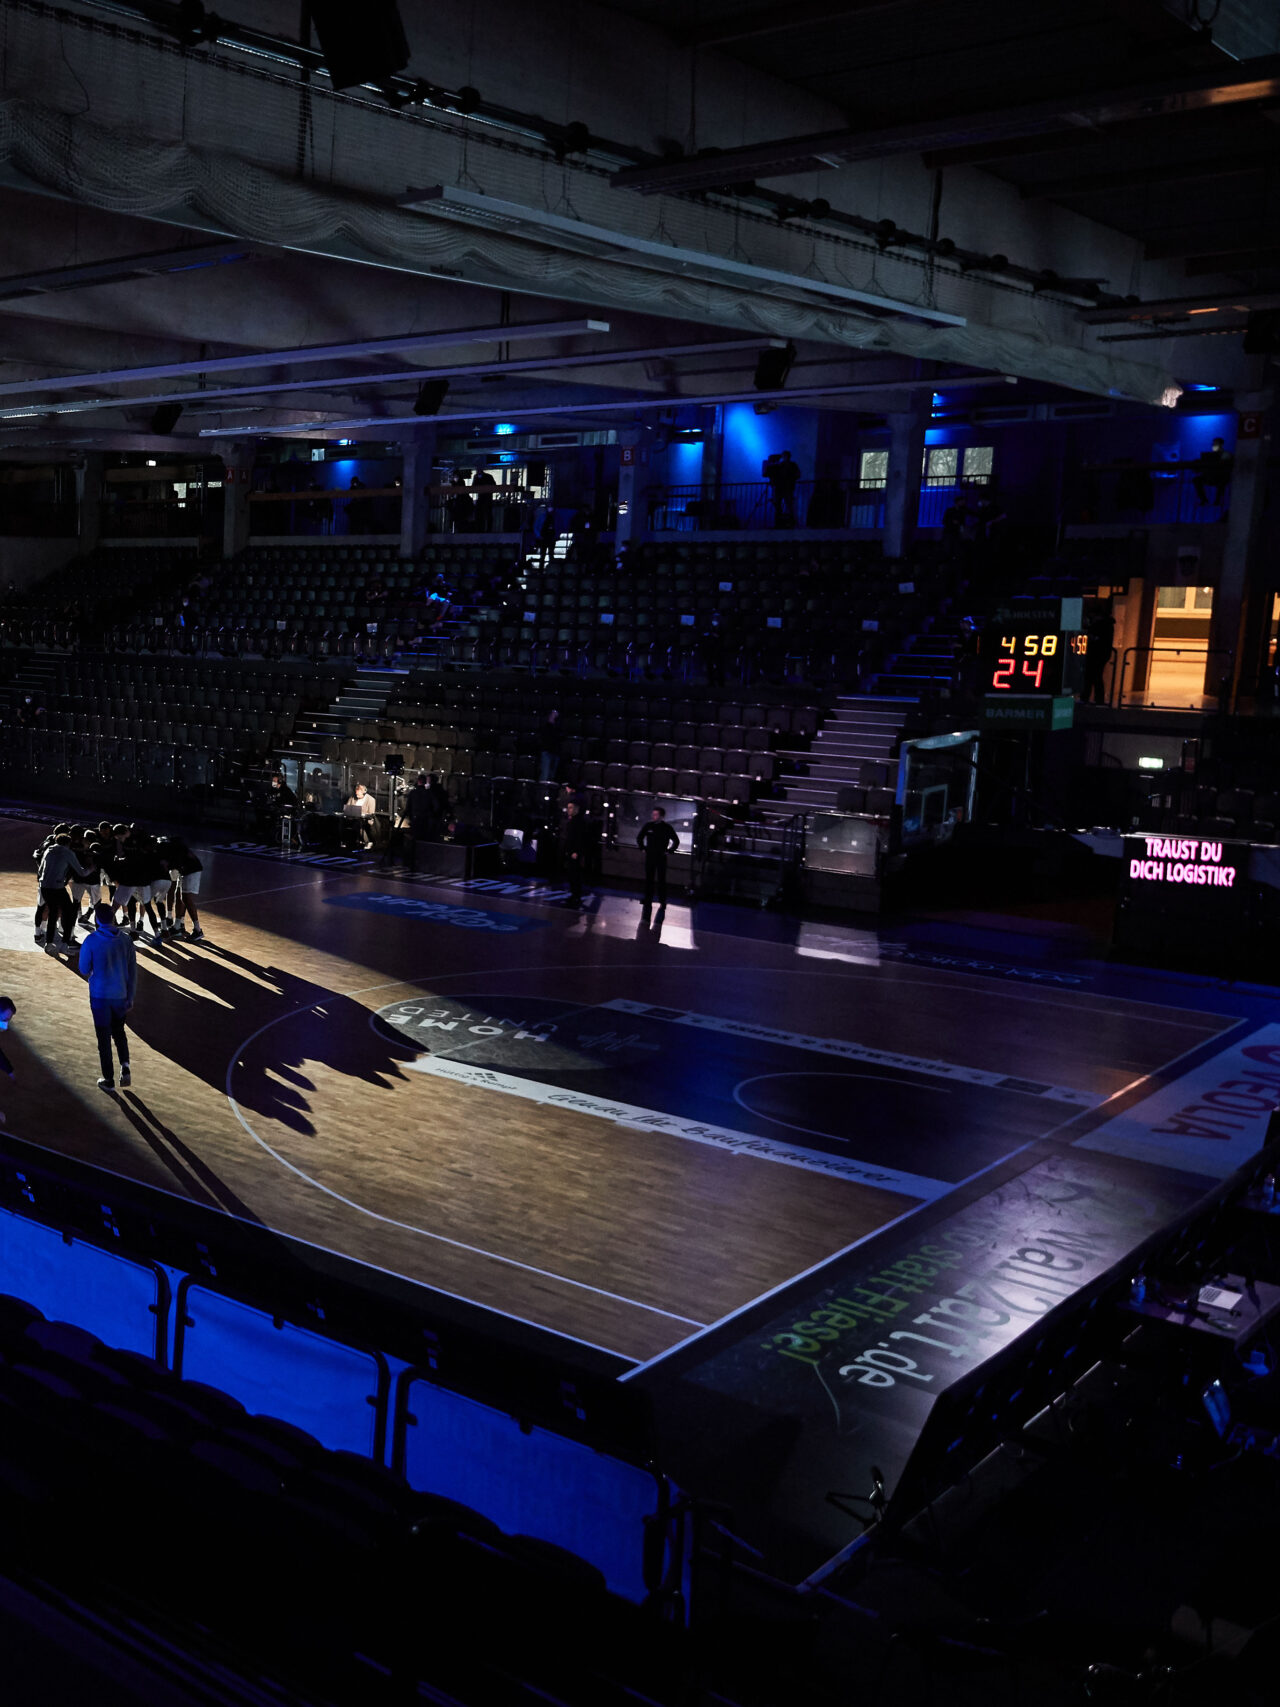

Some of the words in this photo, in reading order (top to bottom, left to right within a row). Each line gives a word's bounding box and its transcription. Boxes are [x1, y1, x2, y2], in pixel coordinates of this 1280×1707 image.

[992, 658, 1044, 689] 24
[985, 708, 1046, 720] BARMER
[1145, 838, 1199, 861] TRAUST
[1200, 841, 1223, 863] DU
[1129, 859, 1165, 881] DICH
[1166, 862, 1236, 888] LOGISTIK?
[388, 1013, 551, 1043] HOME
[397, 1005, 559, 1033] UNITED
[547, 1093, 628, 1117] Genau
[681, 1125, 902, 1183] Baufinanzierer
[868, 1243, 964, 1294] statt
